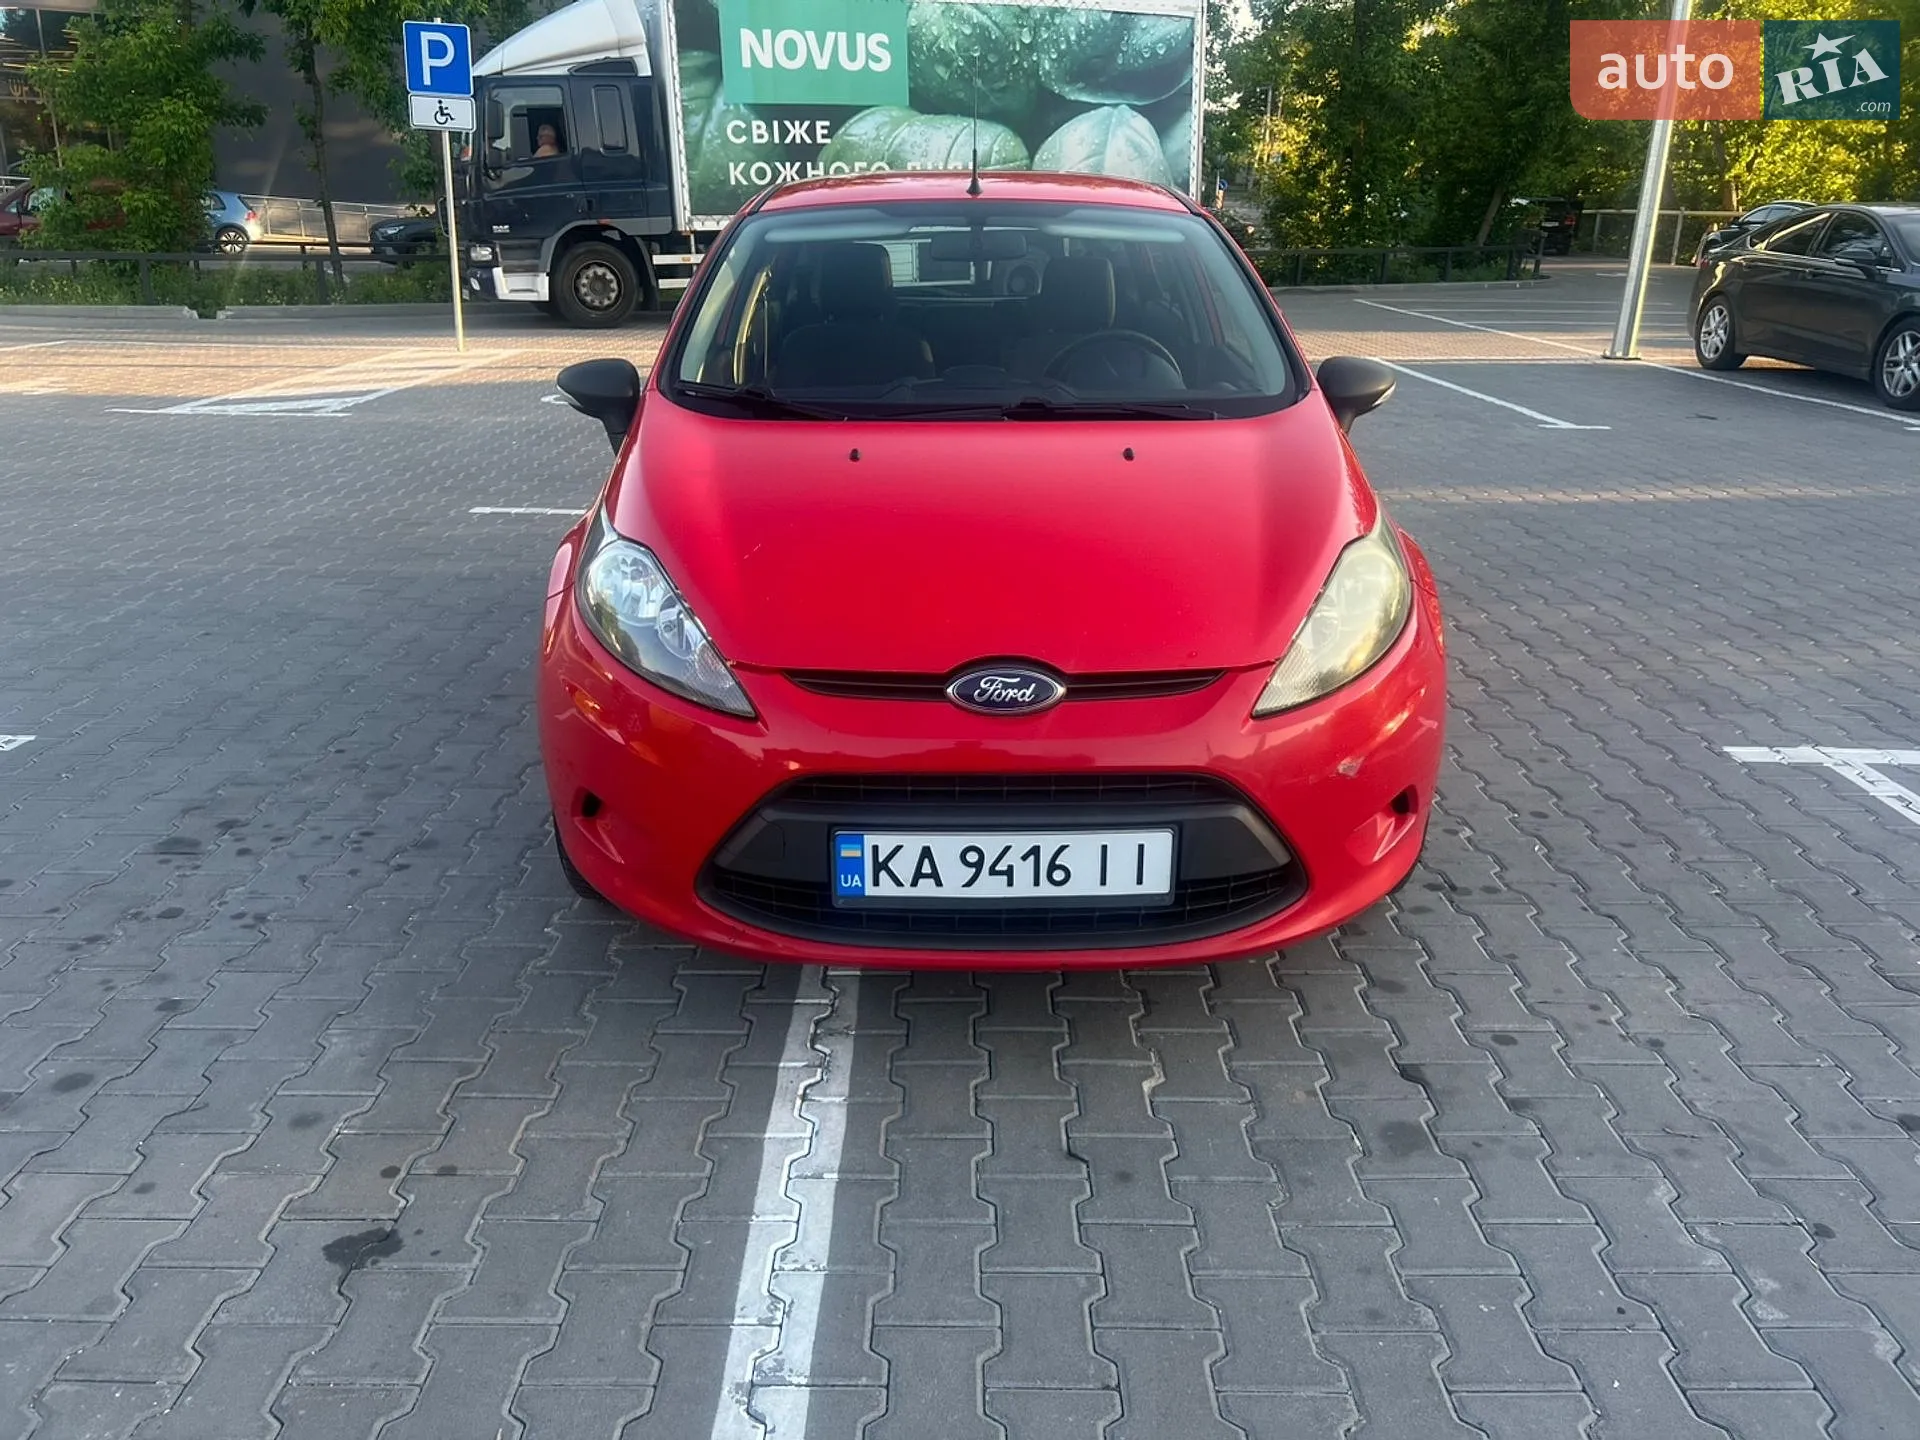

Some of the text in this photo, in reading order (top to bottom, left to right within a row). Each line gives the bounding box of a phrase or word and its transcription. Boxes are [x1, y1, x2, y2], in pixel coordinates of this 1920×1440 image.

[420, 31, 455, 86] P
[740, 27, 892, 72] NOVUS
[726, 119, 832, 145] СВІЖЕ
[974, 676, 1036, 702] Ford
[840, 874, 862, 888] UA
[871, 844, 943, 888] KA
[959, 844, 1072, 888] 9416
